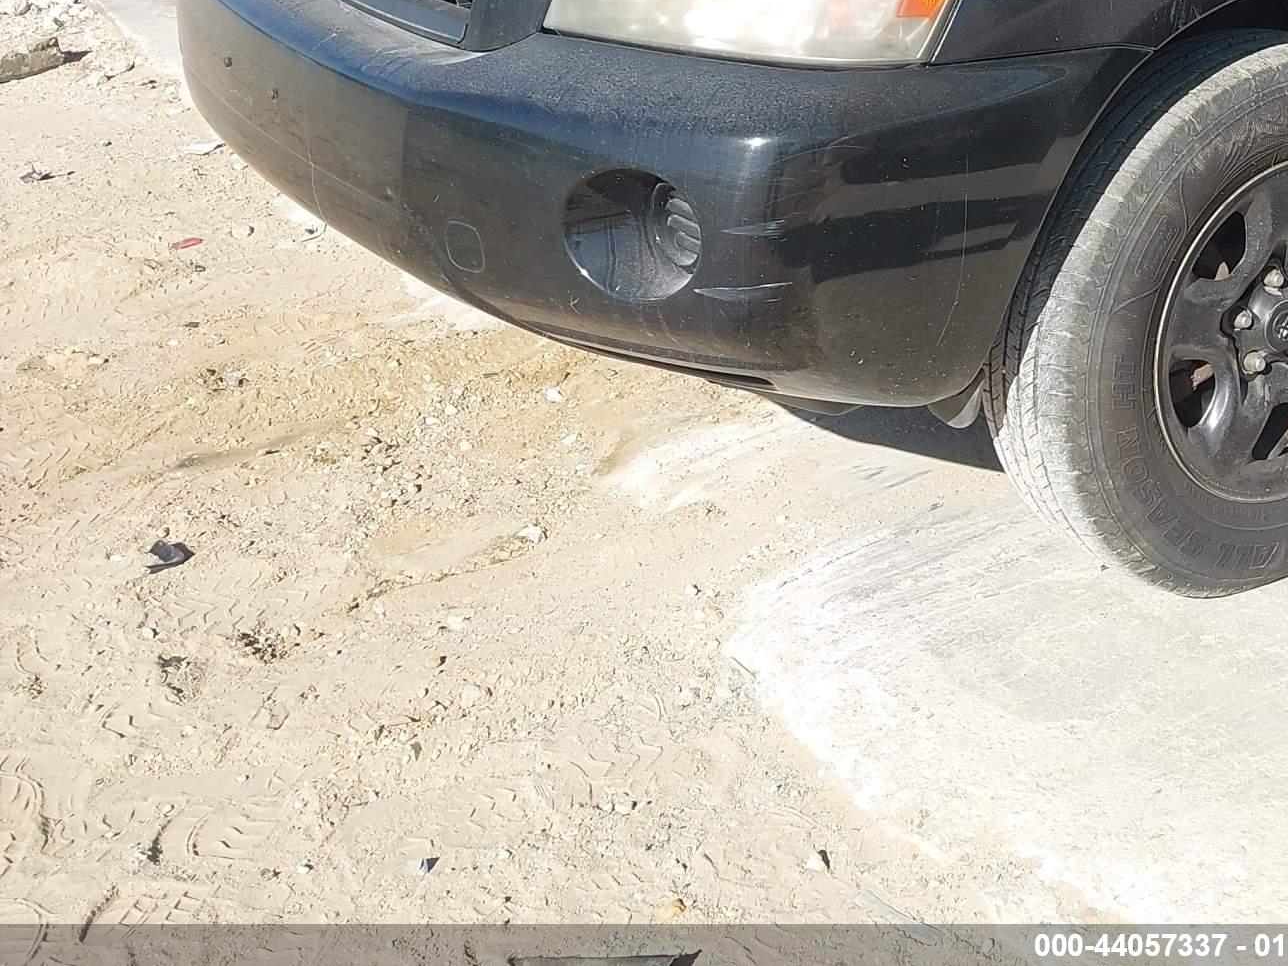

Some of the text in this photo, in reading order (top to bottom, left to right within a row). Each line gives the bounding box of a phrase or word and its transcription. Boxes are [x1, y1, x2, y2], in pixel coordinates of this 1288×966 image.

[1111, 354, 1136, 410] HT
[1115, 425, 1206, 557] SEASON
[1213, 540, 1280, 571] ALL
